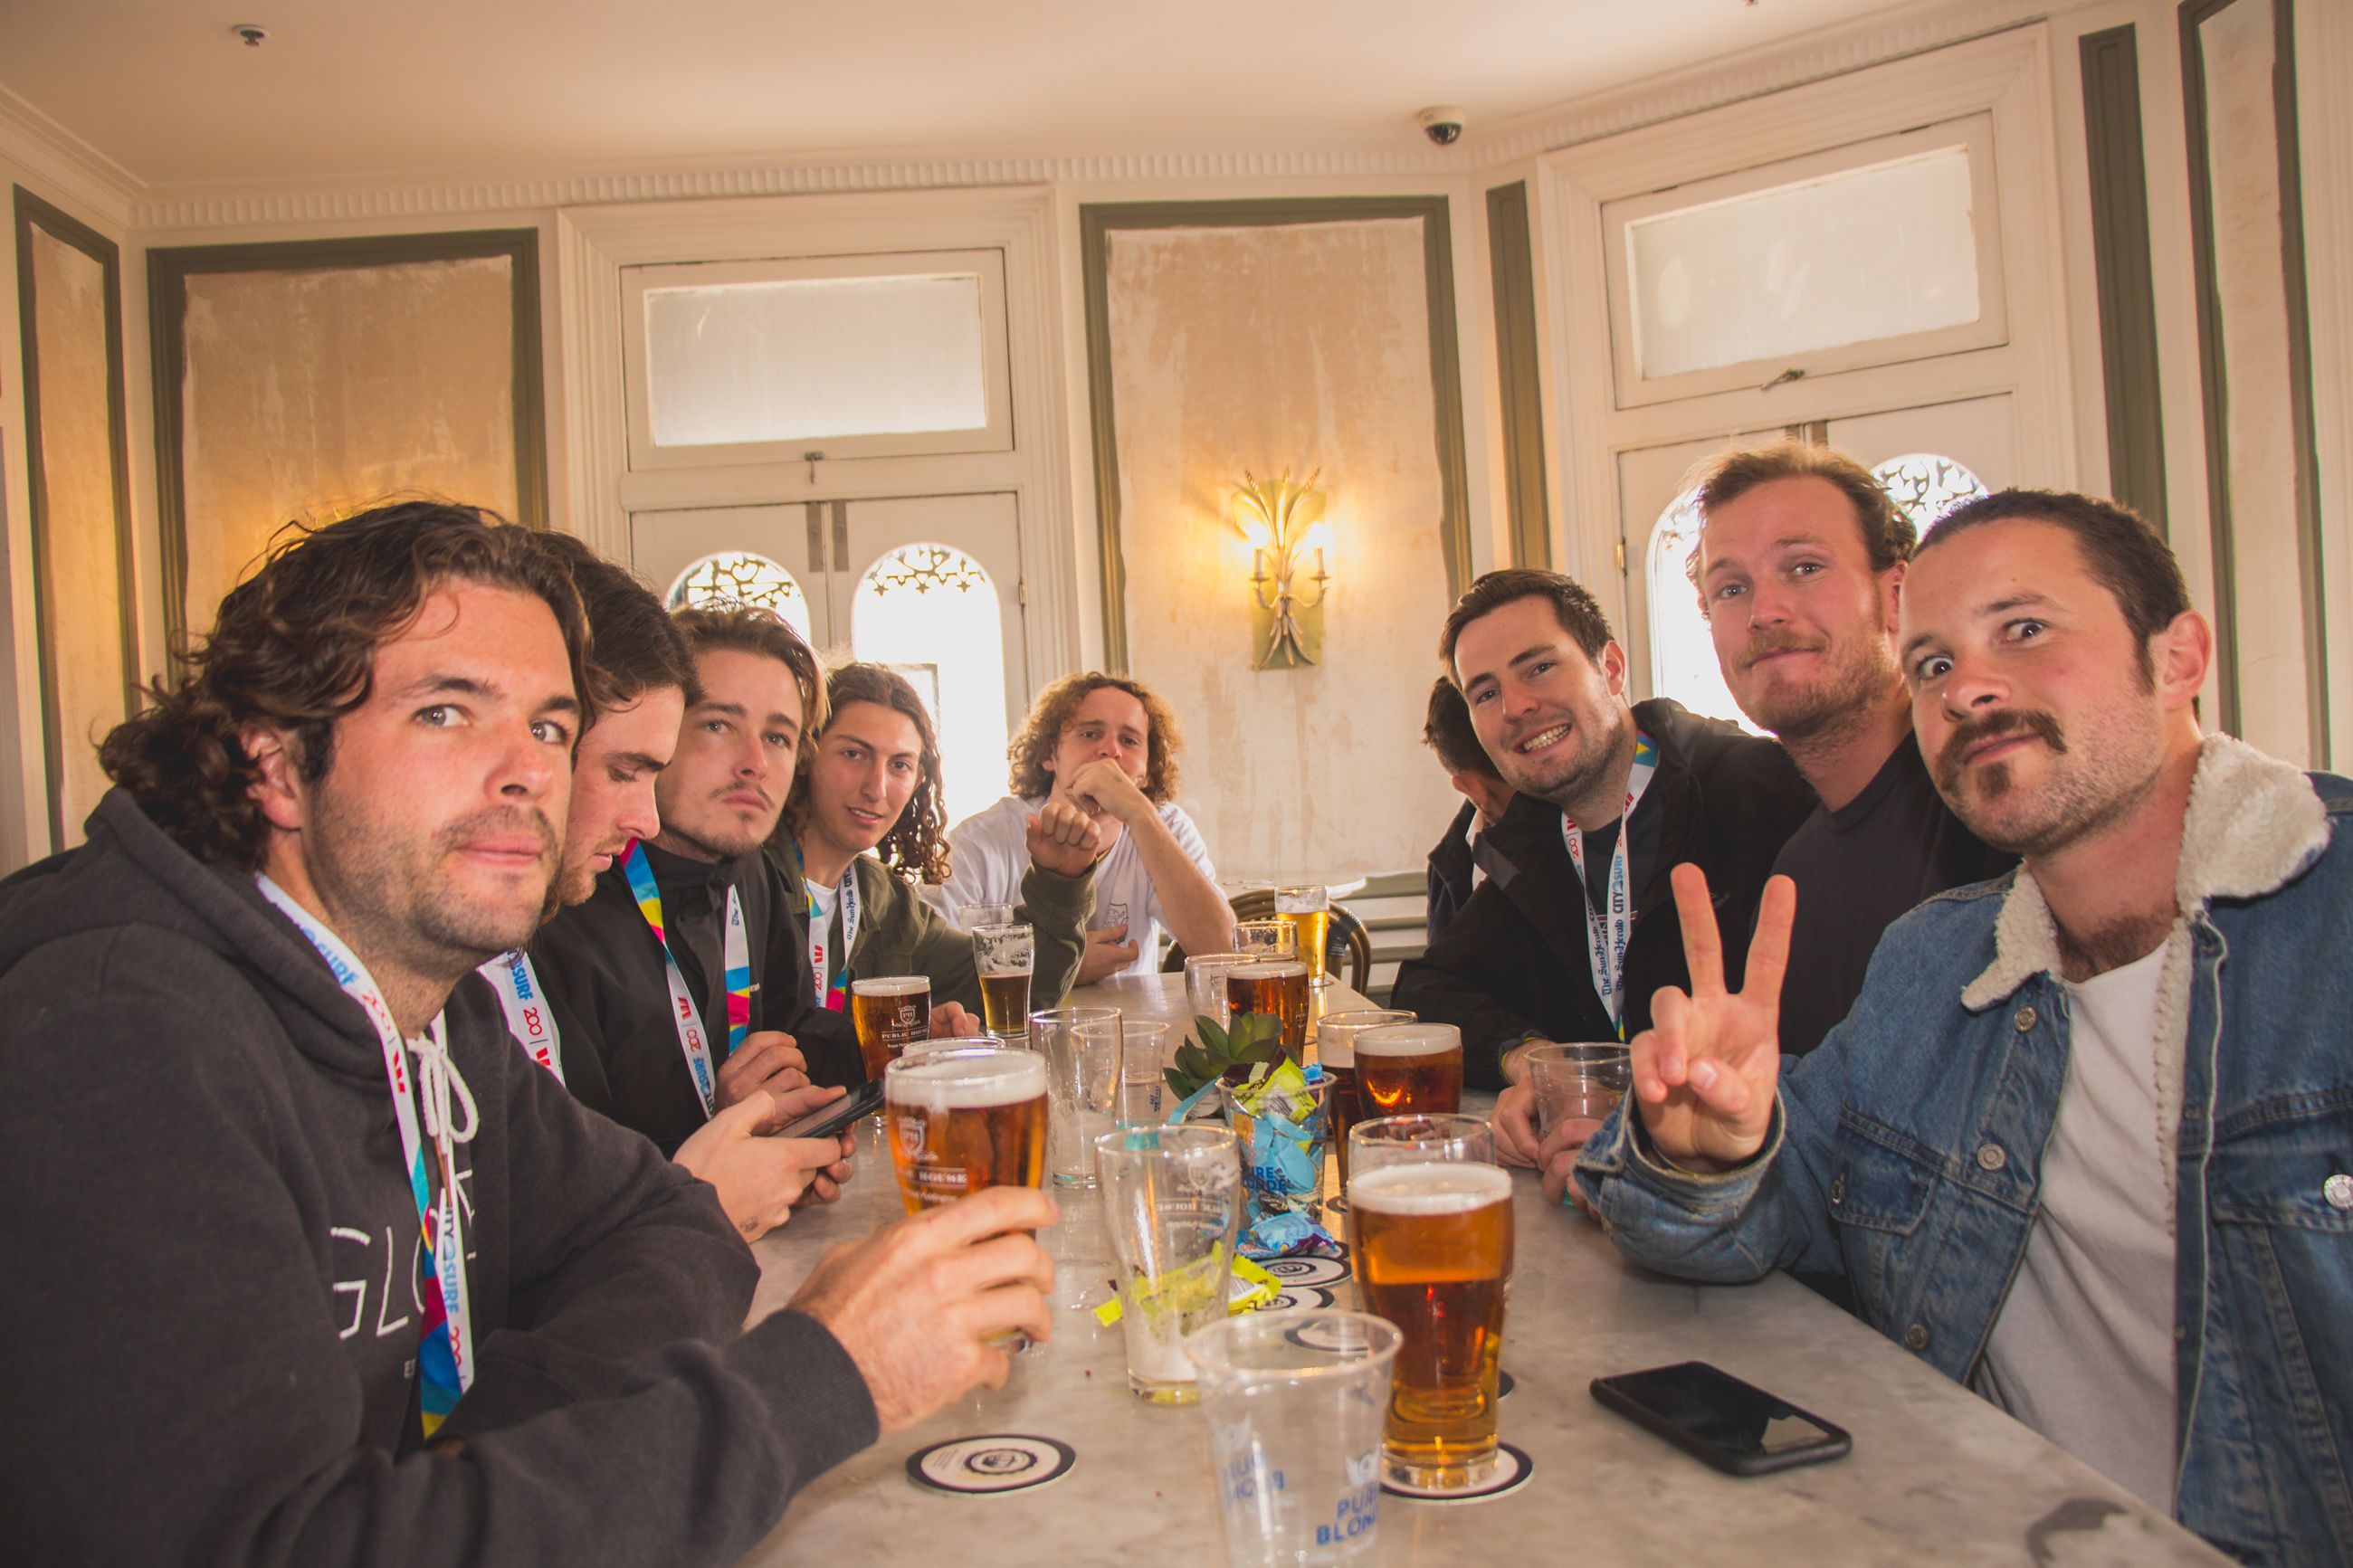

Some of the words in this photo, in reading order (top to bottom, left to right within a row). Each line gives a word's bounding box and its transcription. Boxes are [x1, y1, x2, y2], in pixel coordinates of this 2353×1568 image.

[523, 1007, 542, 1035] 200
[881, 1031, 909, 1040] PUBLIC
[443, 1206, 460, 1315] ITY2SURF
[1337, 1487, 1377, 1520] PUR
[1316, 1513, 1376, 1546] BLON
